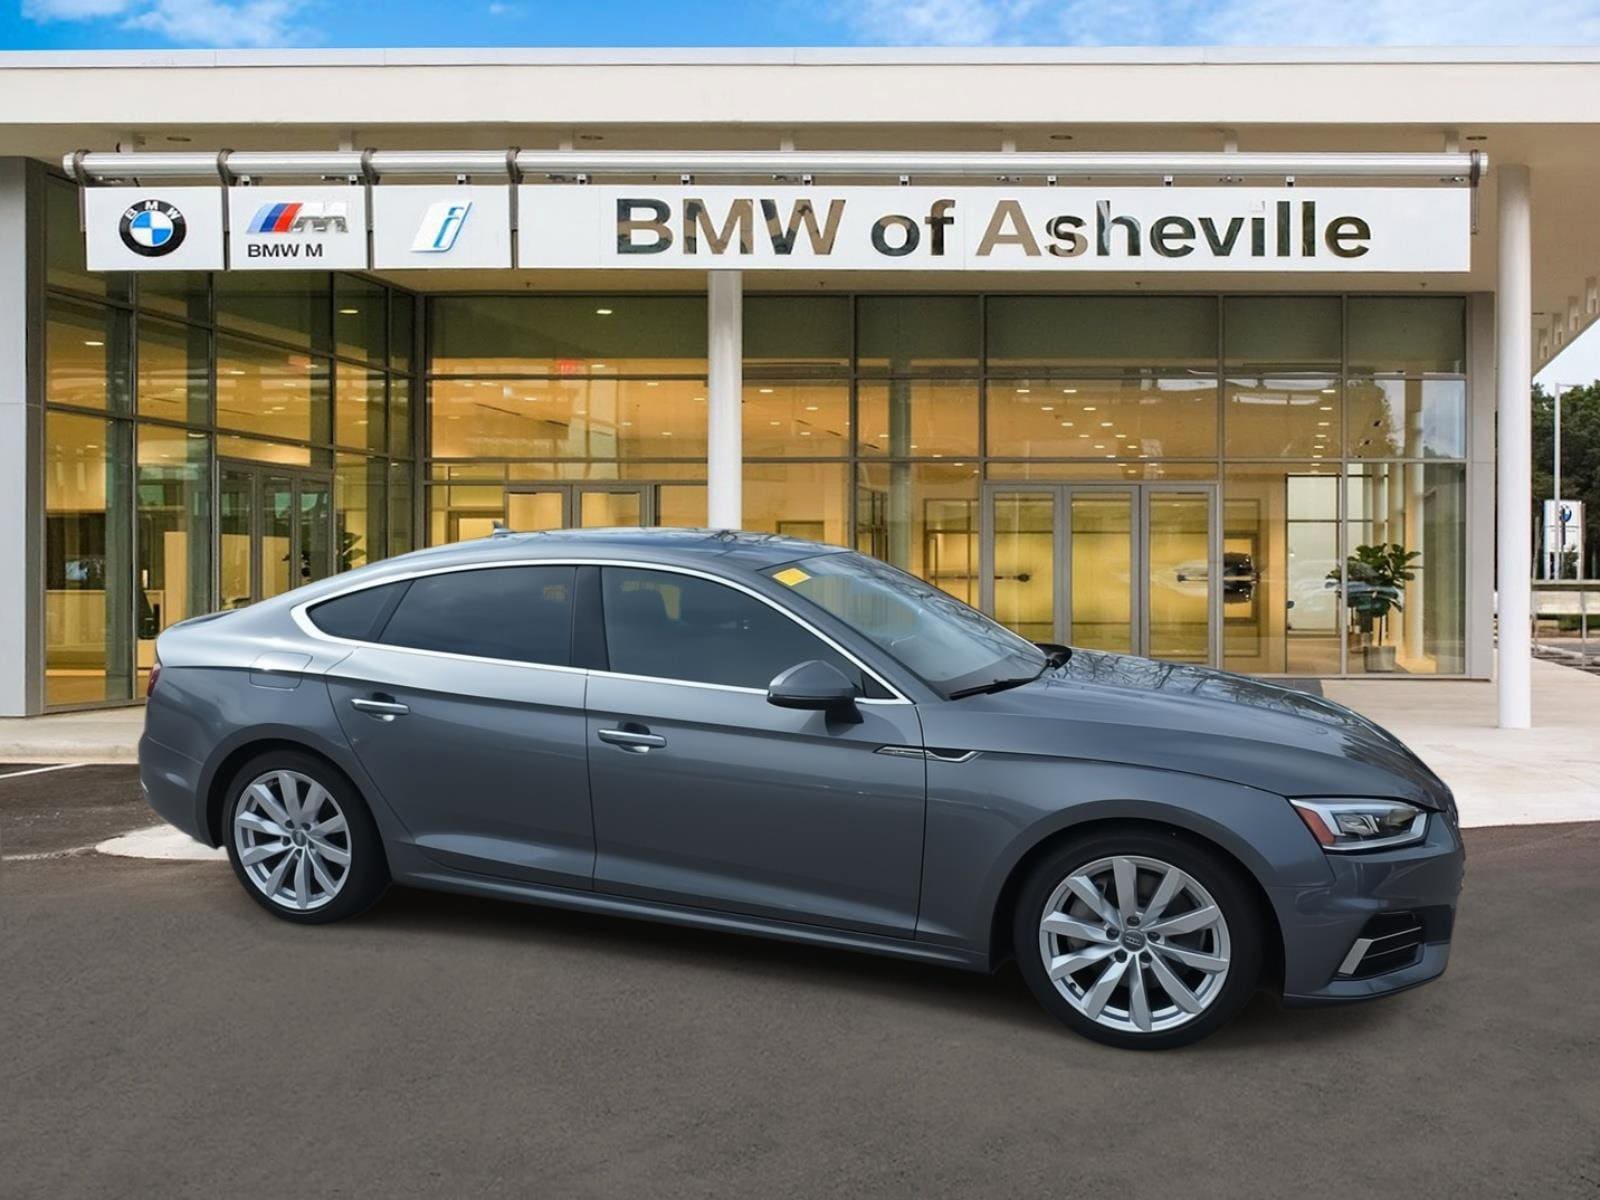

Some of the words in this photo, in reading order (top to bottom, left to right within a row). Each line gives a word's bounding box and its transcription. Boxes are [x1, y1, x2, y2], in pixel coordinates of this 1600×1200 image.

[124, 200, 182, 220] BMW
[616, 198, 846, 256] BMW
[870, 199, 956, 257] of
[975, 199, 1372, 258] Asheville
[247, 243, 300, 258] BMW
[305, 243, 324, 257] M
